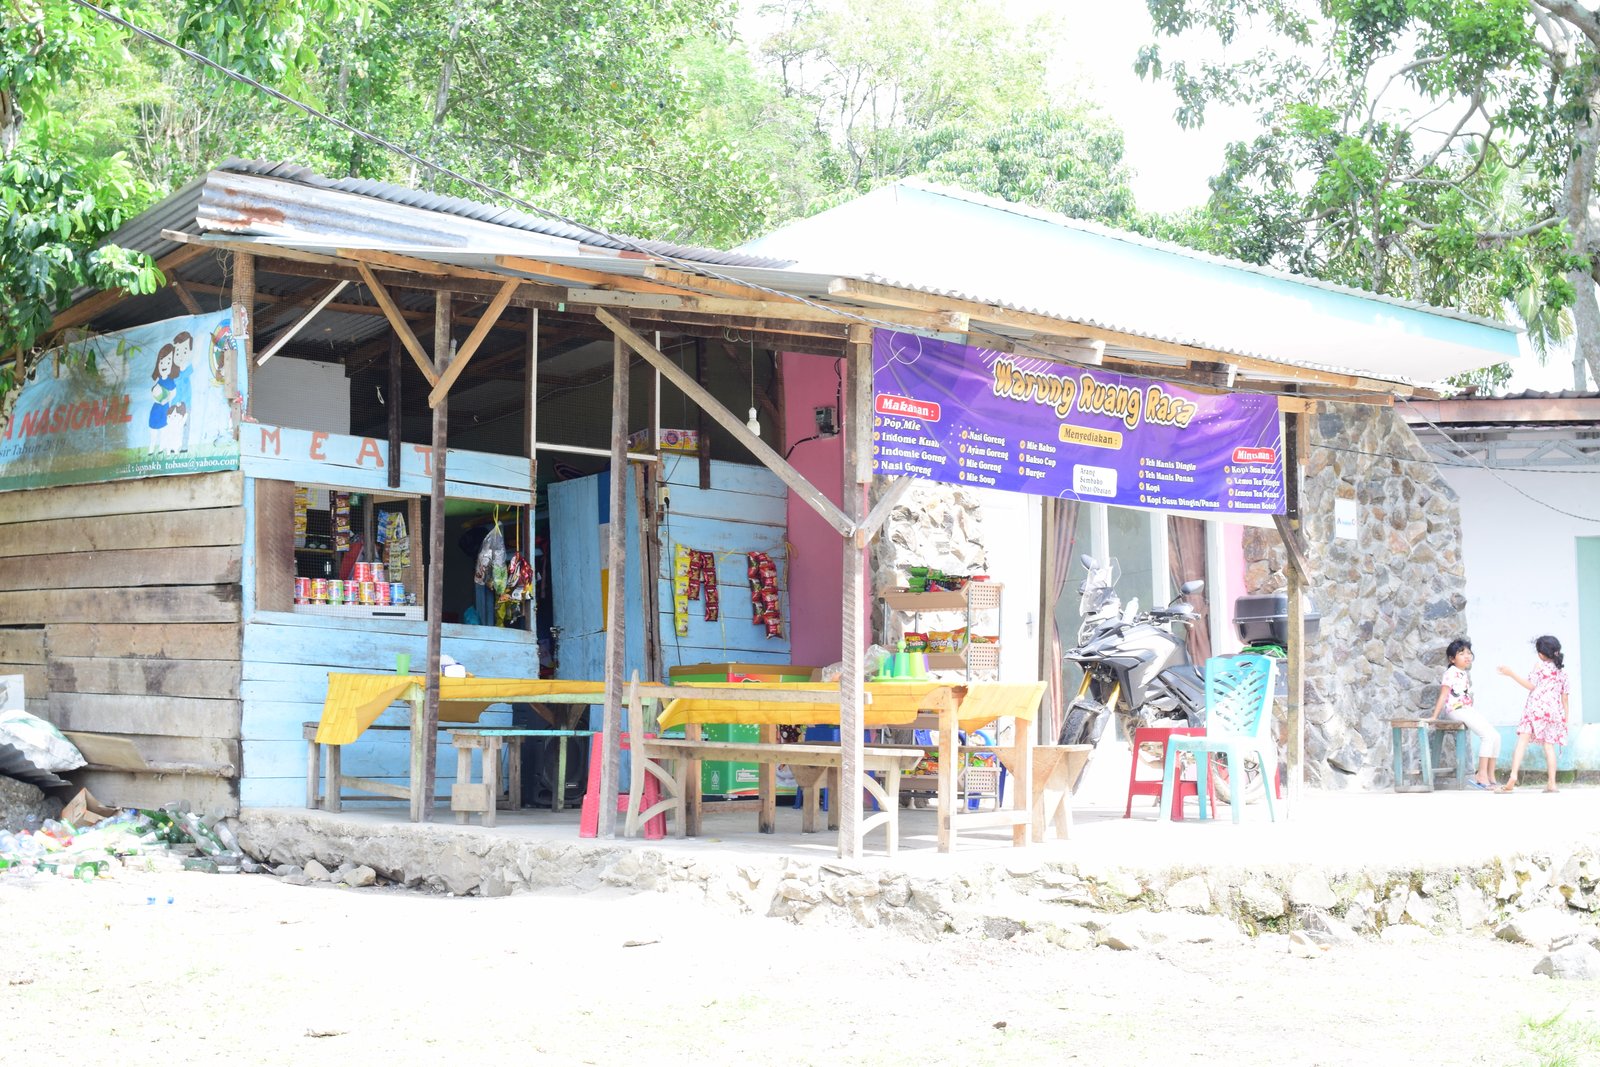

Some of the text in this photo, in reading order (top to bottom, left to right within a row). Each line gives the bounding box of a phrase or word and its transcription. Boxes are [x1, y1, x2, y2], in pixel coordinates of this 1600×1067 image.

[994, 360, 1197, 429] Warung Ruang Rasa
[882, 398, 929, 416] Makanan
[18, 394, 133, 439] NASIONAL
[883, 417, 921, 431] Pop Mie
[969, 431, 1006, 447] Nasi Goreng
[1065, 428, 1113, 445] Menyediakan
[13, 443, 41, 456] Tahun
[881, 446, 920, 459] Indomie
[967, 445, 1009, 461] Ayam Goreng
[1026, 441, 1057, 453] Mie Bakso
[966, 459, 1002, 474] Mie Goreng
[1025, 454, 1057, 468] Bakso Cup
[1145, 458, 1197, 472] Teh Manis Dingin
[881, 460, 932, 477] Nasi Goreng
[1025, 467, 1046, 479] Burger
[1231, 465, 1249, 475] Kopi
[1261, 466, 1276, 475] Panas
[966, 472, 996, 486] Mie Soup
[1145, 470, 1194, 483] Teh Manis Panas
[1145, 483, 1161, 493] Kopi
[1253, 489, 1263, 498] Tea
[1263, 490, 1280, 498] Panas
[1146, 495, 1220, 508] Kopi Susu Dingin/Panas
[1234, 500, 1277, 510] Minuman Botol
